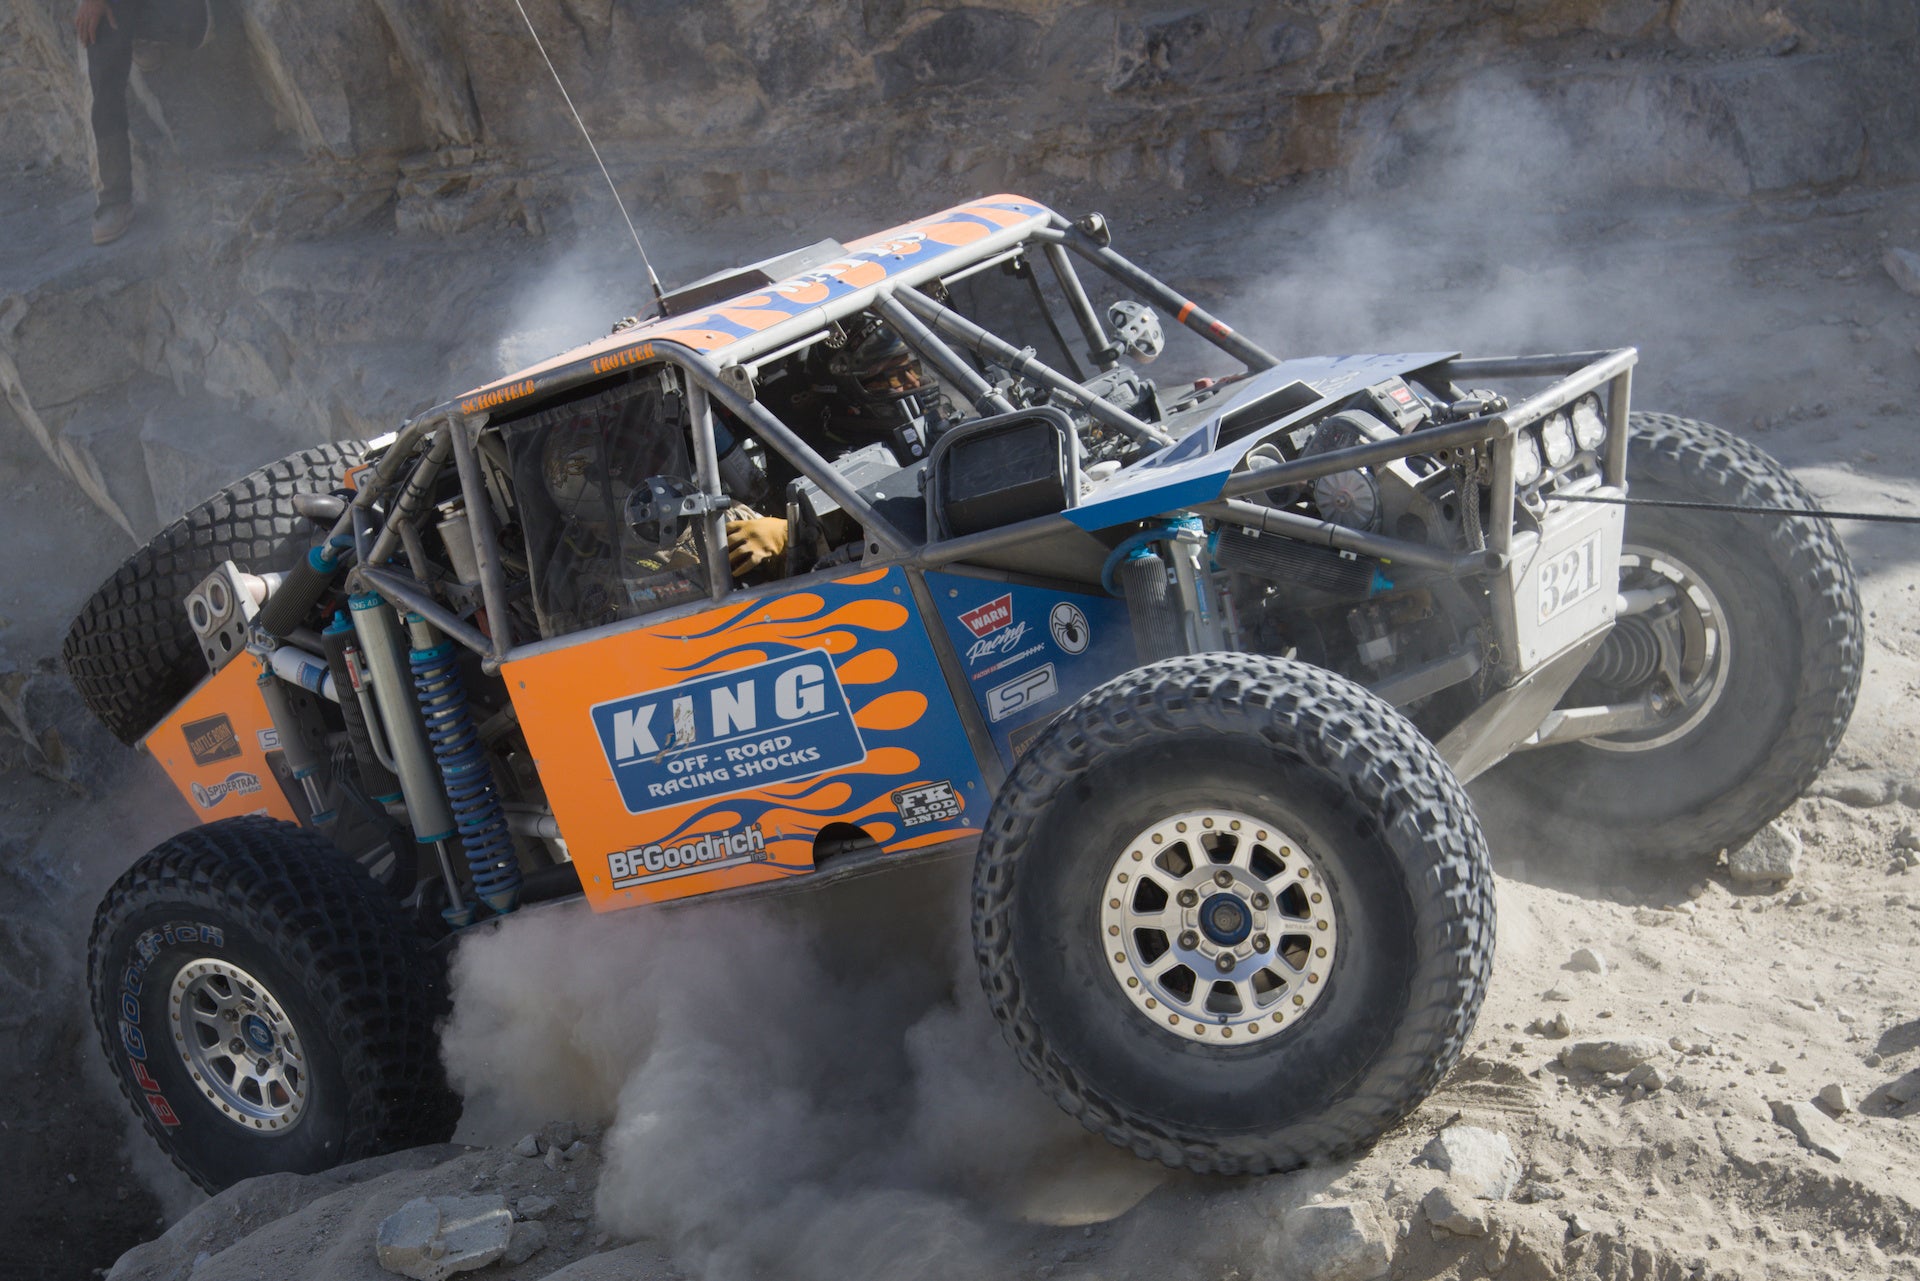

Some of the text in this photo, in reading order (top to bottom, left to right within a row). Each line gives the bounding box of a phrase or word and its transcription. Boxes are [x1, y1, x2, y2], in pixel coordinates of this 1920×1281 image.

[590, 343, 655, 375] TROTTER
[461, 380, 535, 415] SCHOFIELD
[1541, 538, 1599, 617] 321
[970, 605, 1008, 629] WARN
[966, 621, 1033, 665] Racing
[999, 670, 1050, 714] SP
[613, 664, 826, 760] KING
[191, 730, 215, 754] BATTLE
[263, 730, 281, 747] S
[207, 775, 259, 797] SPIDERTRAX
[647, 746, 821, 798] RACING SHOCKS
[902, 784, 953, 809] FK
[912, 799, 956, 815] ROD
[903, 807, 960, 827] ENDS
[607, 825, 766, 880] BFGoodrich
